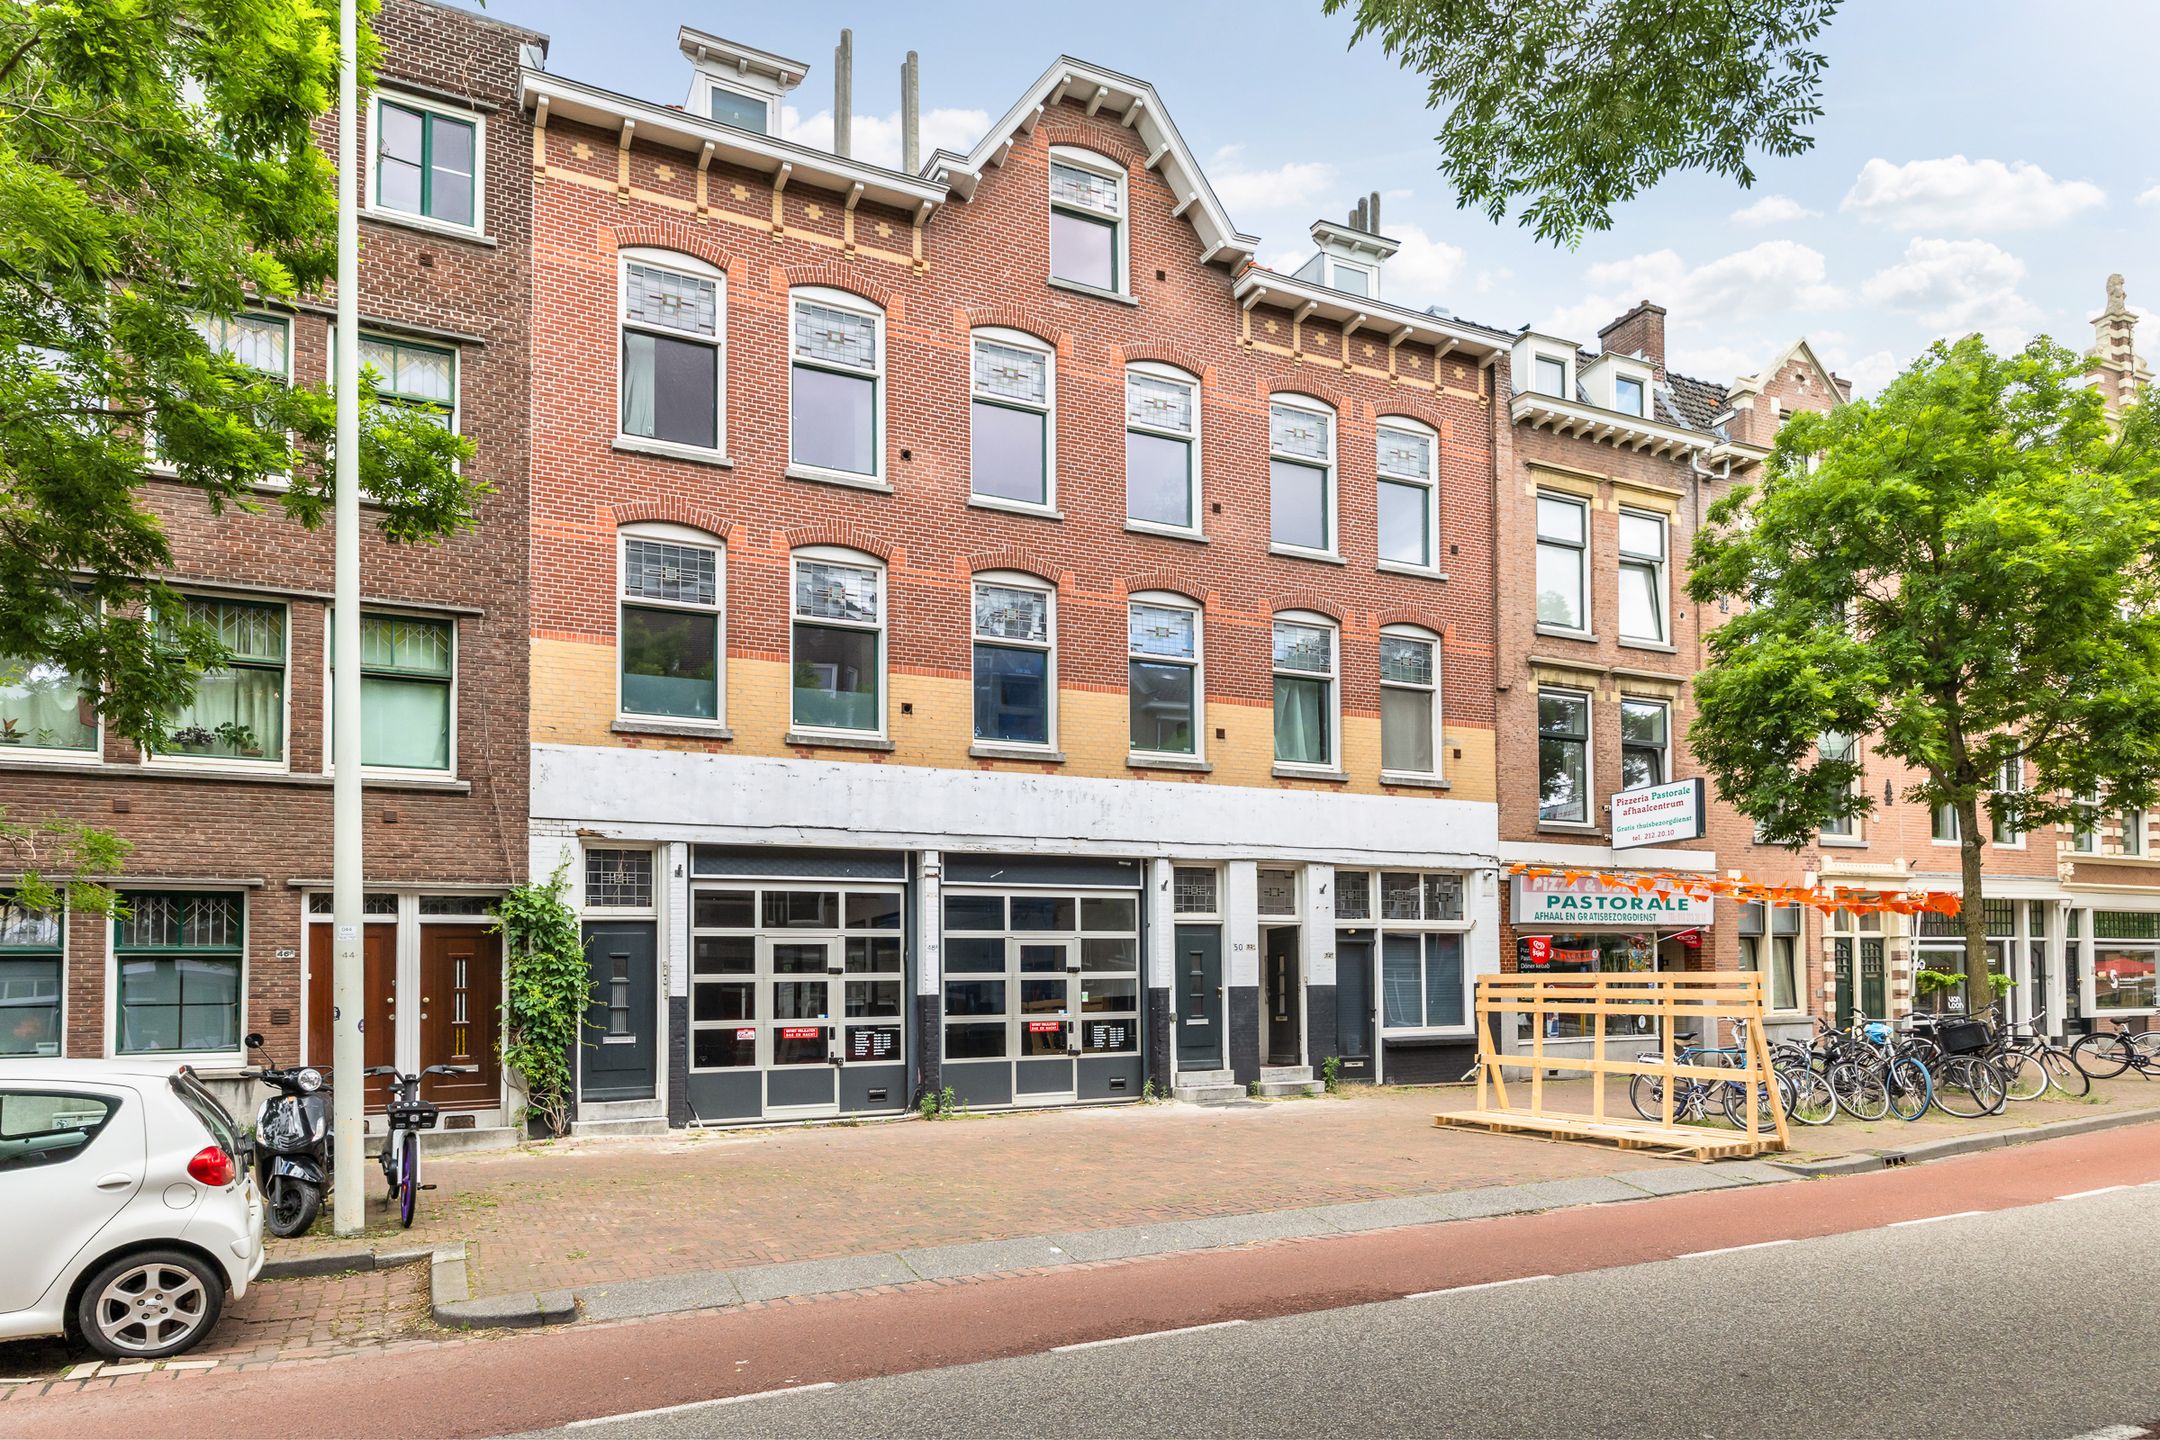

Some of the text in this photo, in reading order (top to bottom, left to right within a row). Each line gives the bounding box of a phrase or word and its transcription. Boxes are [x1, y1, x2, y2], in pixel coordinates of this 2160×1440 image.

[1616, 787, 1691, 806] Pizzeria Pastorale
[1623, 800, 1684, 816] afhaalcentrum
[1636, 816, 1692, 830] thuisbezorgdienst
[1547, 895, 1689, 911] PASTORALE
[1534, 912, 1656, 922] AFHAAL EN GRATISBEZORGDIENST
